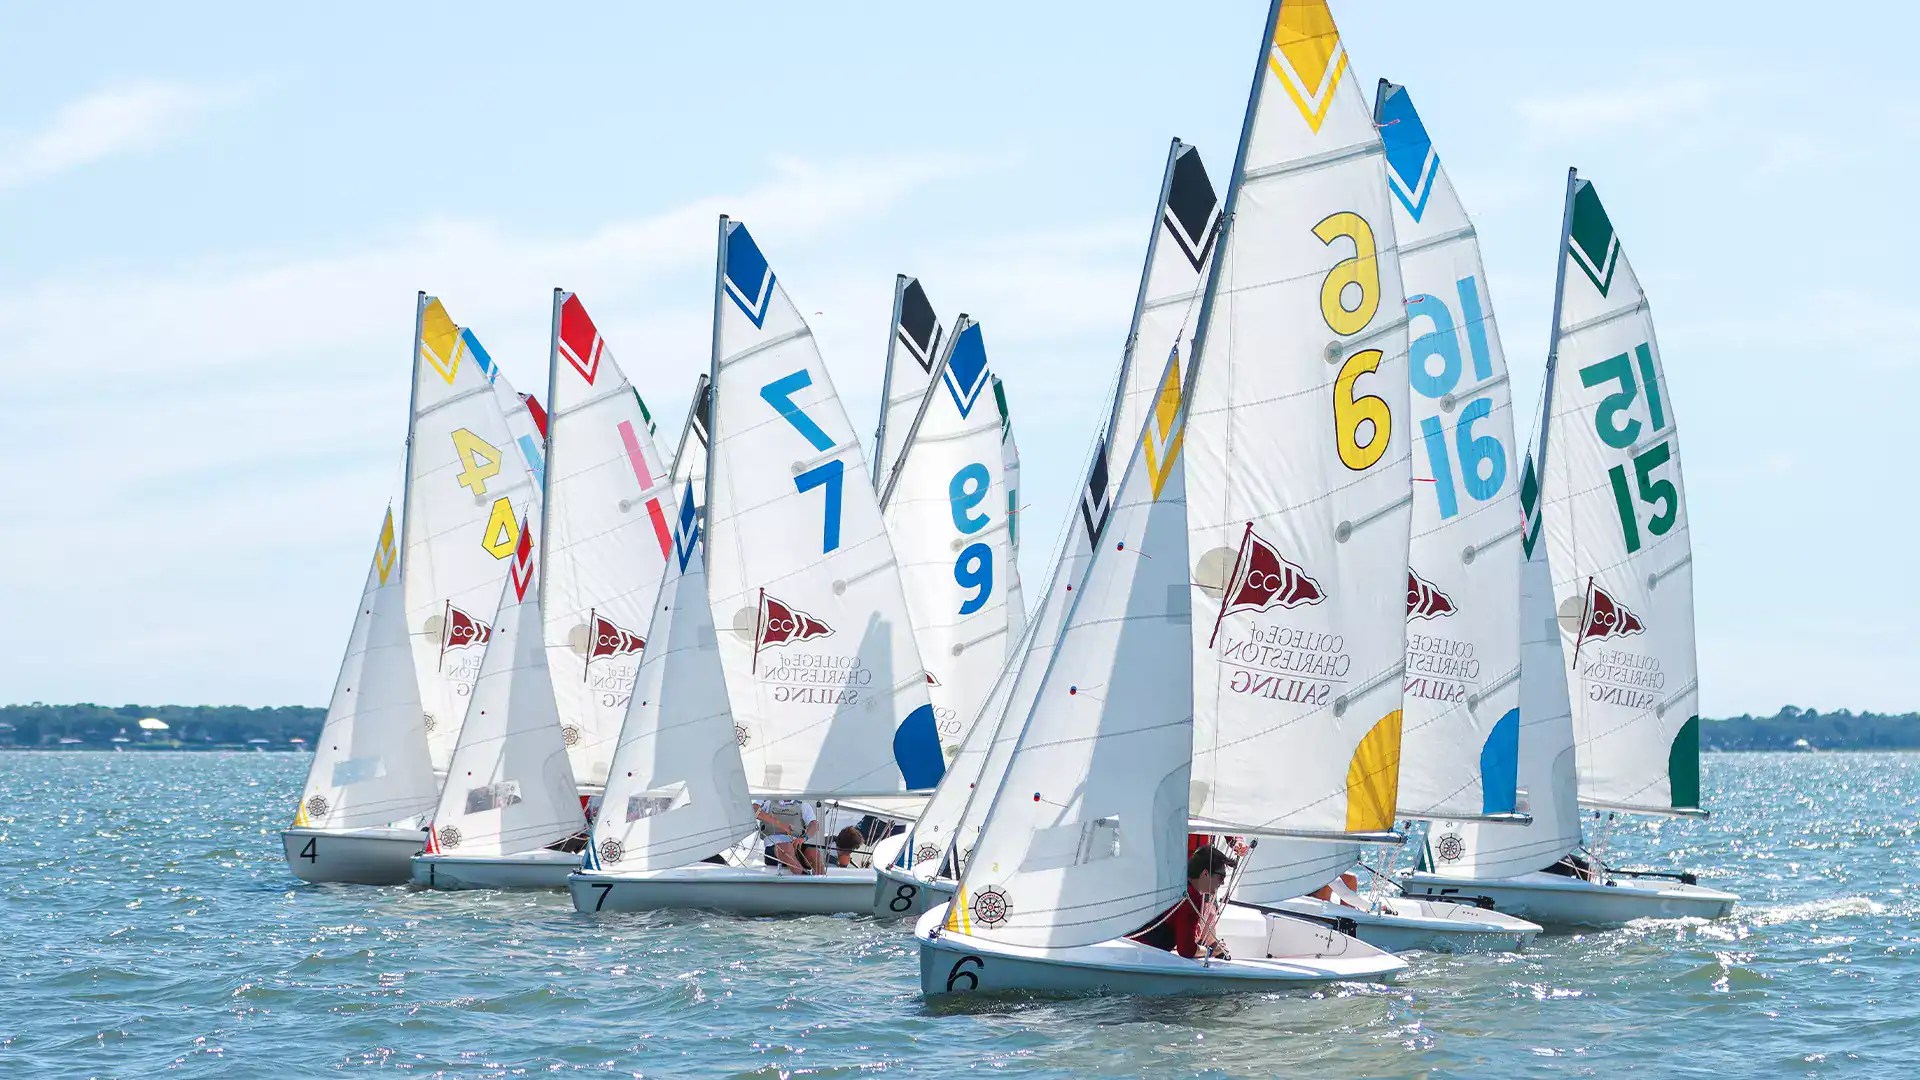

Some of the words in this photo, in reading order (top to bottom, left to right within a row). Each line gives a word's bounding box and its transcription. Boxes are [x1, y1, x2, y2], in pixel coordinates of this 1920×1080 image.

[1333, 348, 1392, 471] 6
[1420, 397, 1507, 521] 16
[793, 459, 844, 554] 7
[1608, 440, 1678, 554] 15
[954, 542, 993, 615] 9
[300, 837, 319, 864] 4
[590, 883, 613, 912] 7
[889, 884, 917, 912] 8
[946, 955, 985, 993] 6
